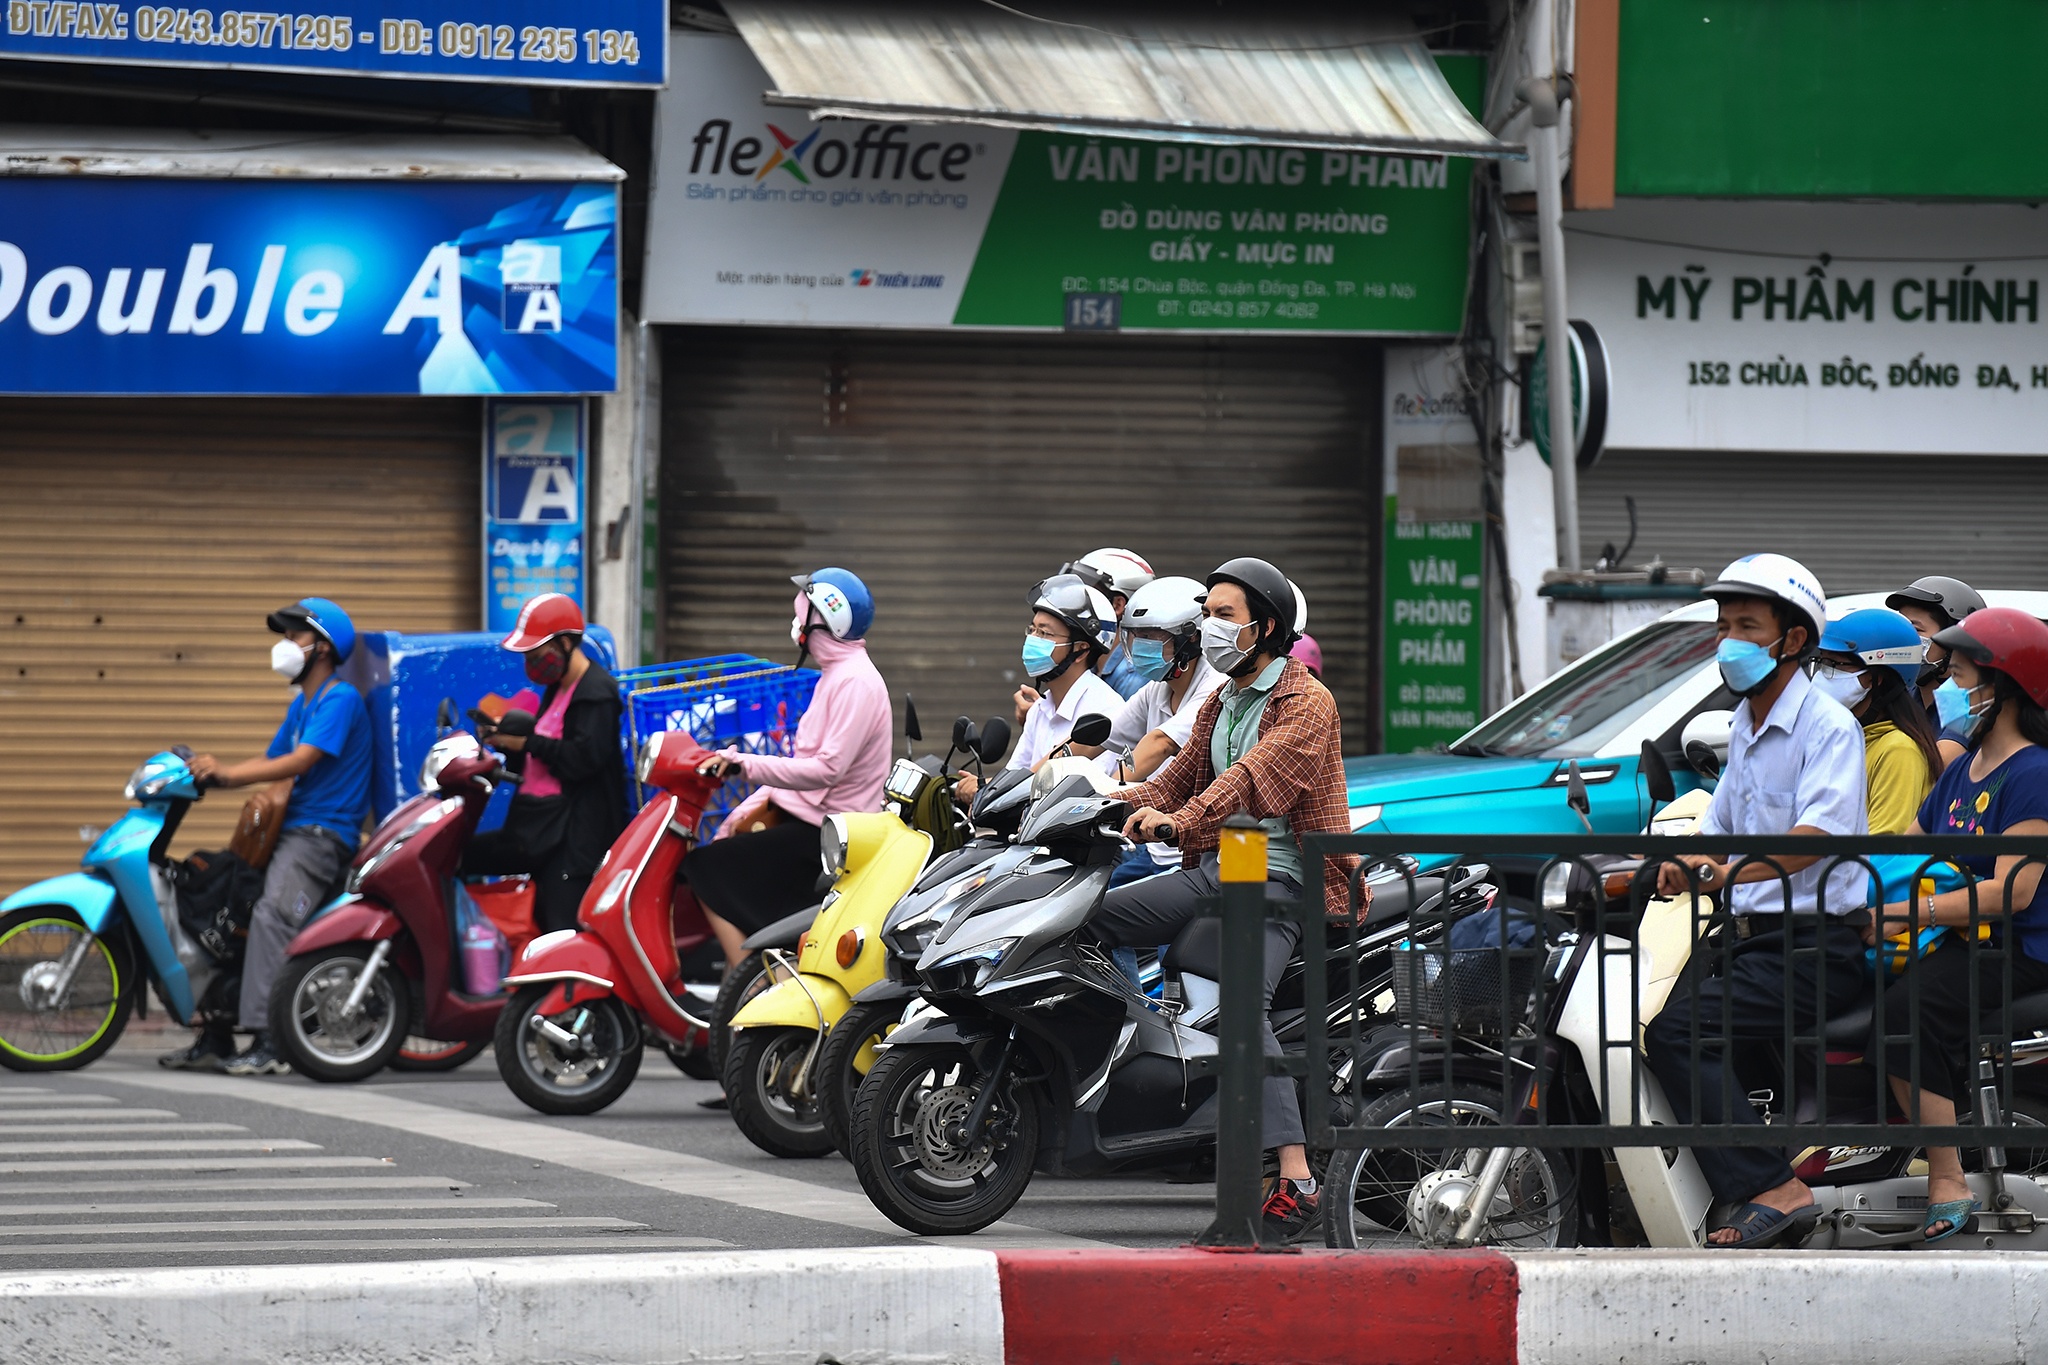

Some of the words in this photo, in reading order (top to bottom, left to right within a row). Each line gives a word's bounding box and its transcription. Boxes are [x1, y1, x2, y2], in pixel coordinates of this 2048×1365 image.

[7, 0, 128, 40] ĐT/FAX:
[135, 6, 352, 51] 0243.8571295
[380, 18, 432, 54] DĐ:
[438, 21, 514, 60] 0912
[519, 26, 577, 62] 235
[583, 28, 640, 65] 134
[791, 186, 827, 202] cho
[906, 189, 969, 208] phòng
[1099, 203, 1138, 230] ĐỒ
[1146, 205, 1222, 231] DÙNG
[1231, 208, 1287, 232] VĂN
[1295, 206, 1389, 235] PHÒNG
[1150, 235, 1213, 263] GIẤY
[1236, 241, 1297, 268] MỰC
[1305, 244, 1335, 265] IN
[382, 242, 463, 334] A
[1637, 264, 1712, 321] MỸ
[1732, 252, 1876, 322] PHẨM
[1891, 264, 2039, 323] CHÍNH
[1070, 298, 1116, 328] 154
[1188, 300, 1234, 318] 0243
[1688, 361, 1731, 386] 152
[1739, 354, 1810, 387] CHÙA
[1888, 352, 1960, 388] ĐỐNG
[1409, 555, 1458, 586] VĂN
[1393, 591, 1473, 626] PHÒNG
